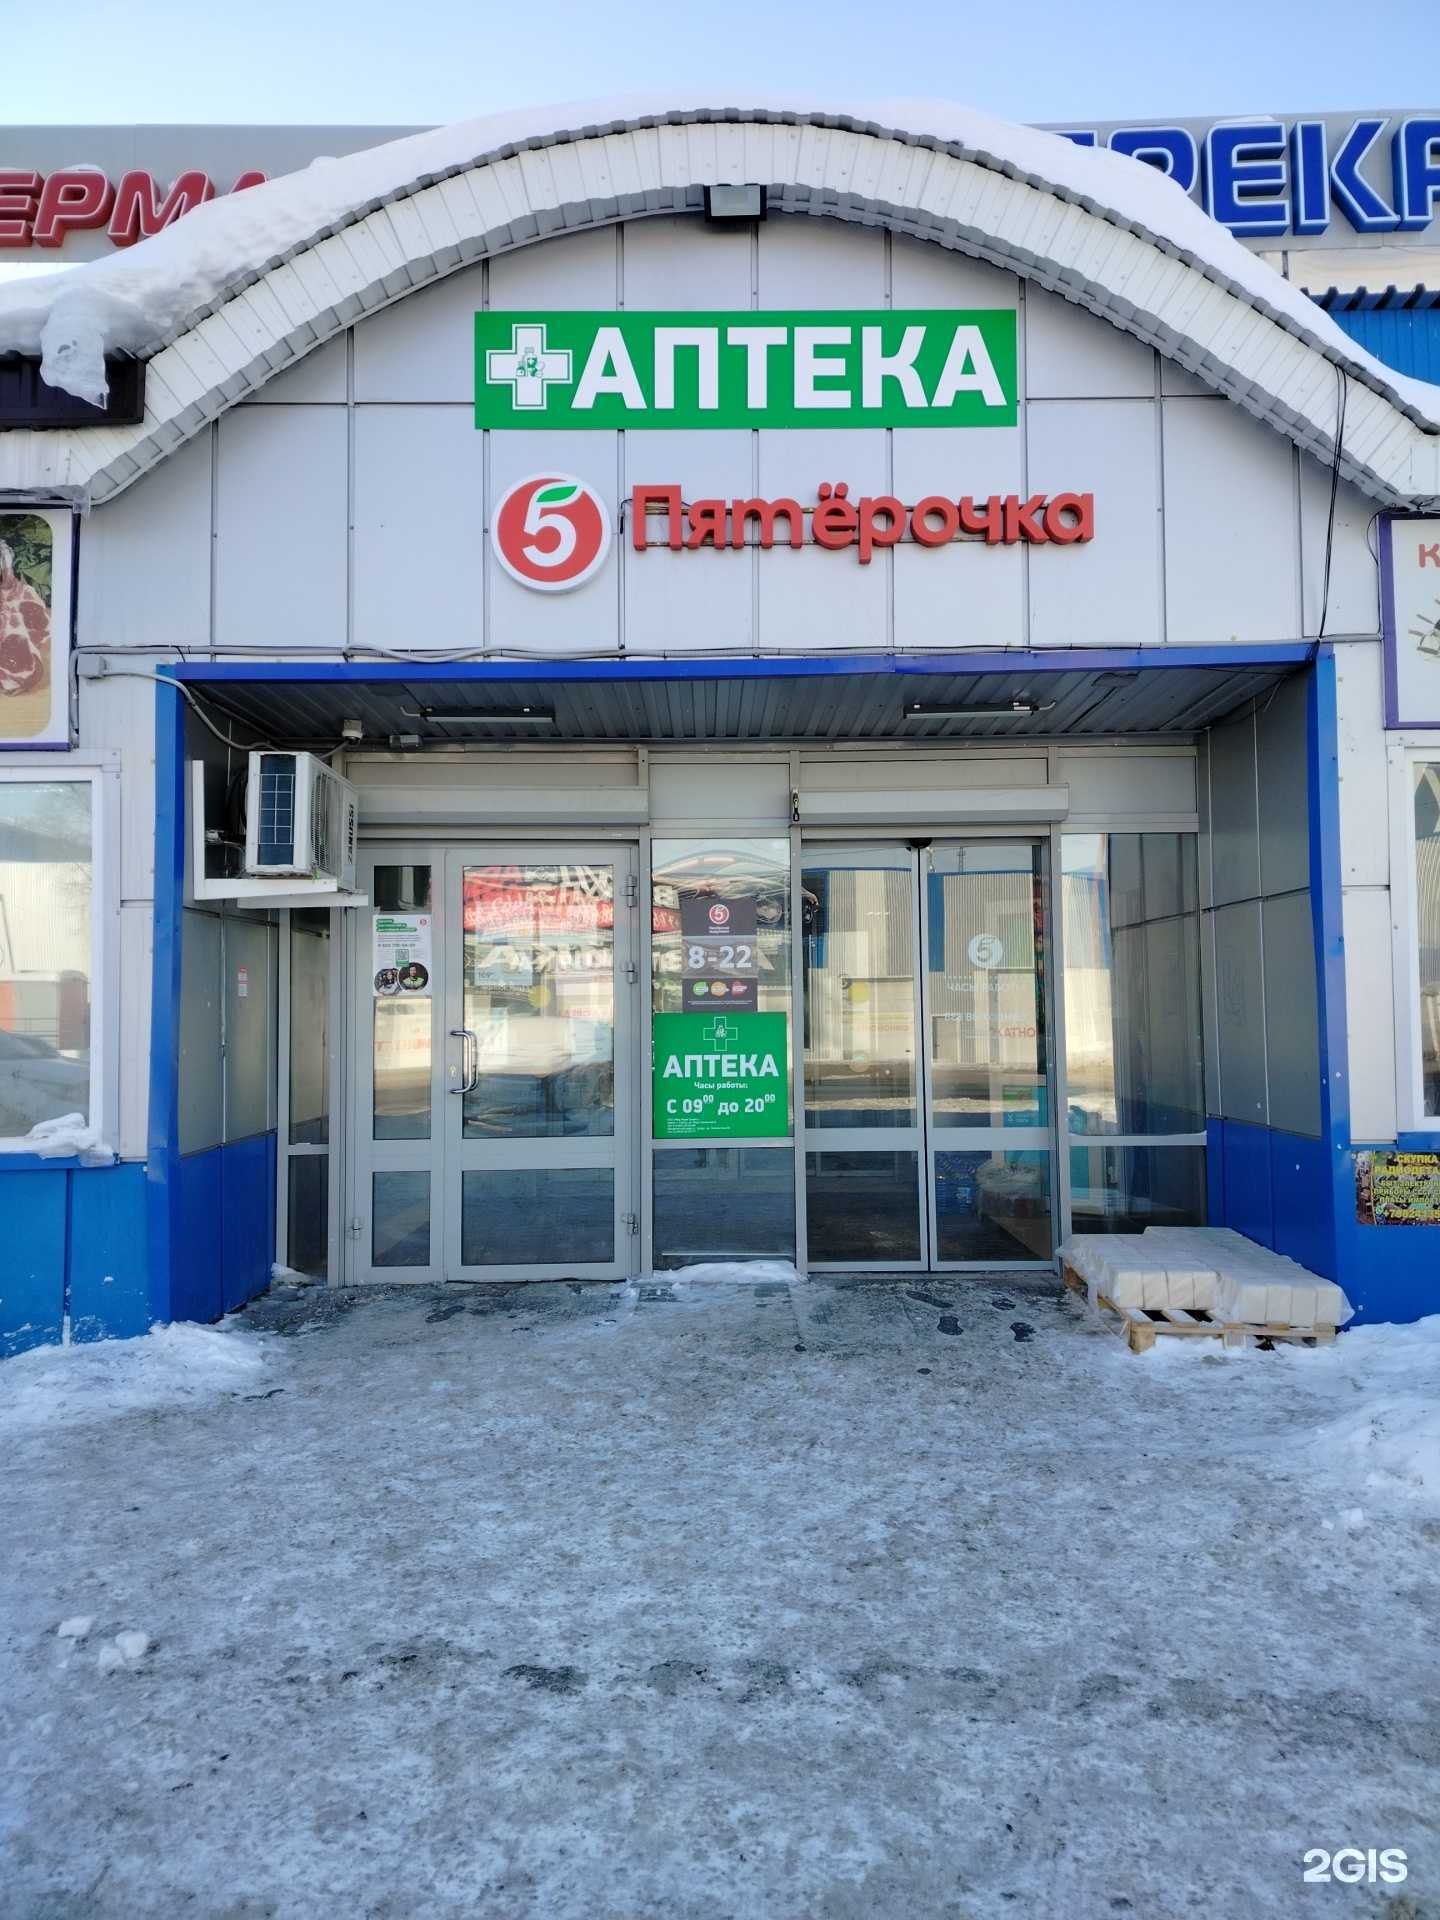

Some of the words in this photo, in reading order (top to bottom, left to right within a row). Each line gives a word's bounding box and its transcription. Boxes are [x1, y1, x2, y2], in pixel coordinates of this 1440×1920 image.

[0, 170, 267, 247] ЕРМ
[1054, 117, 1440, 237] РЕК
[571, 325, 1007, 409] АПТЕКА
[521, 481, 579, 567] 5
[632, 482, 1095, 564] Пятёрочка
[347, 803, 355, 865] ZANUSSI
[662, 1054, 779, 1078] АПТЕКА
[694, 1081, 715, 1089] Часы
[716, 1081, 748, 1090] работы:
[666, 1099, 678, 1114] С
[717, 1102, 740, 1116] до
[1397, 1154, 1438, 1164] СКУПКА
